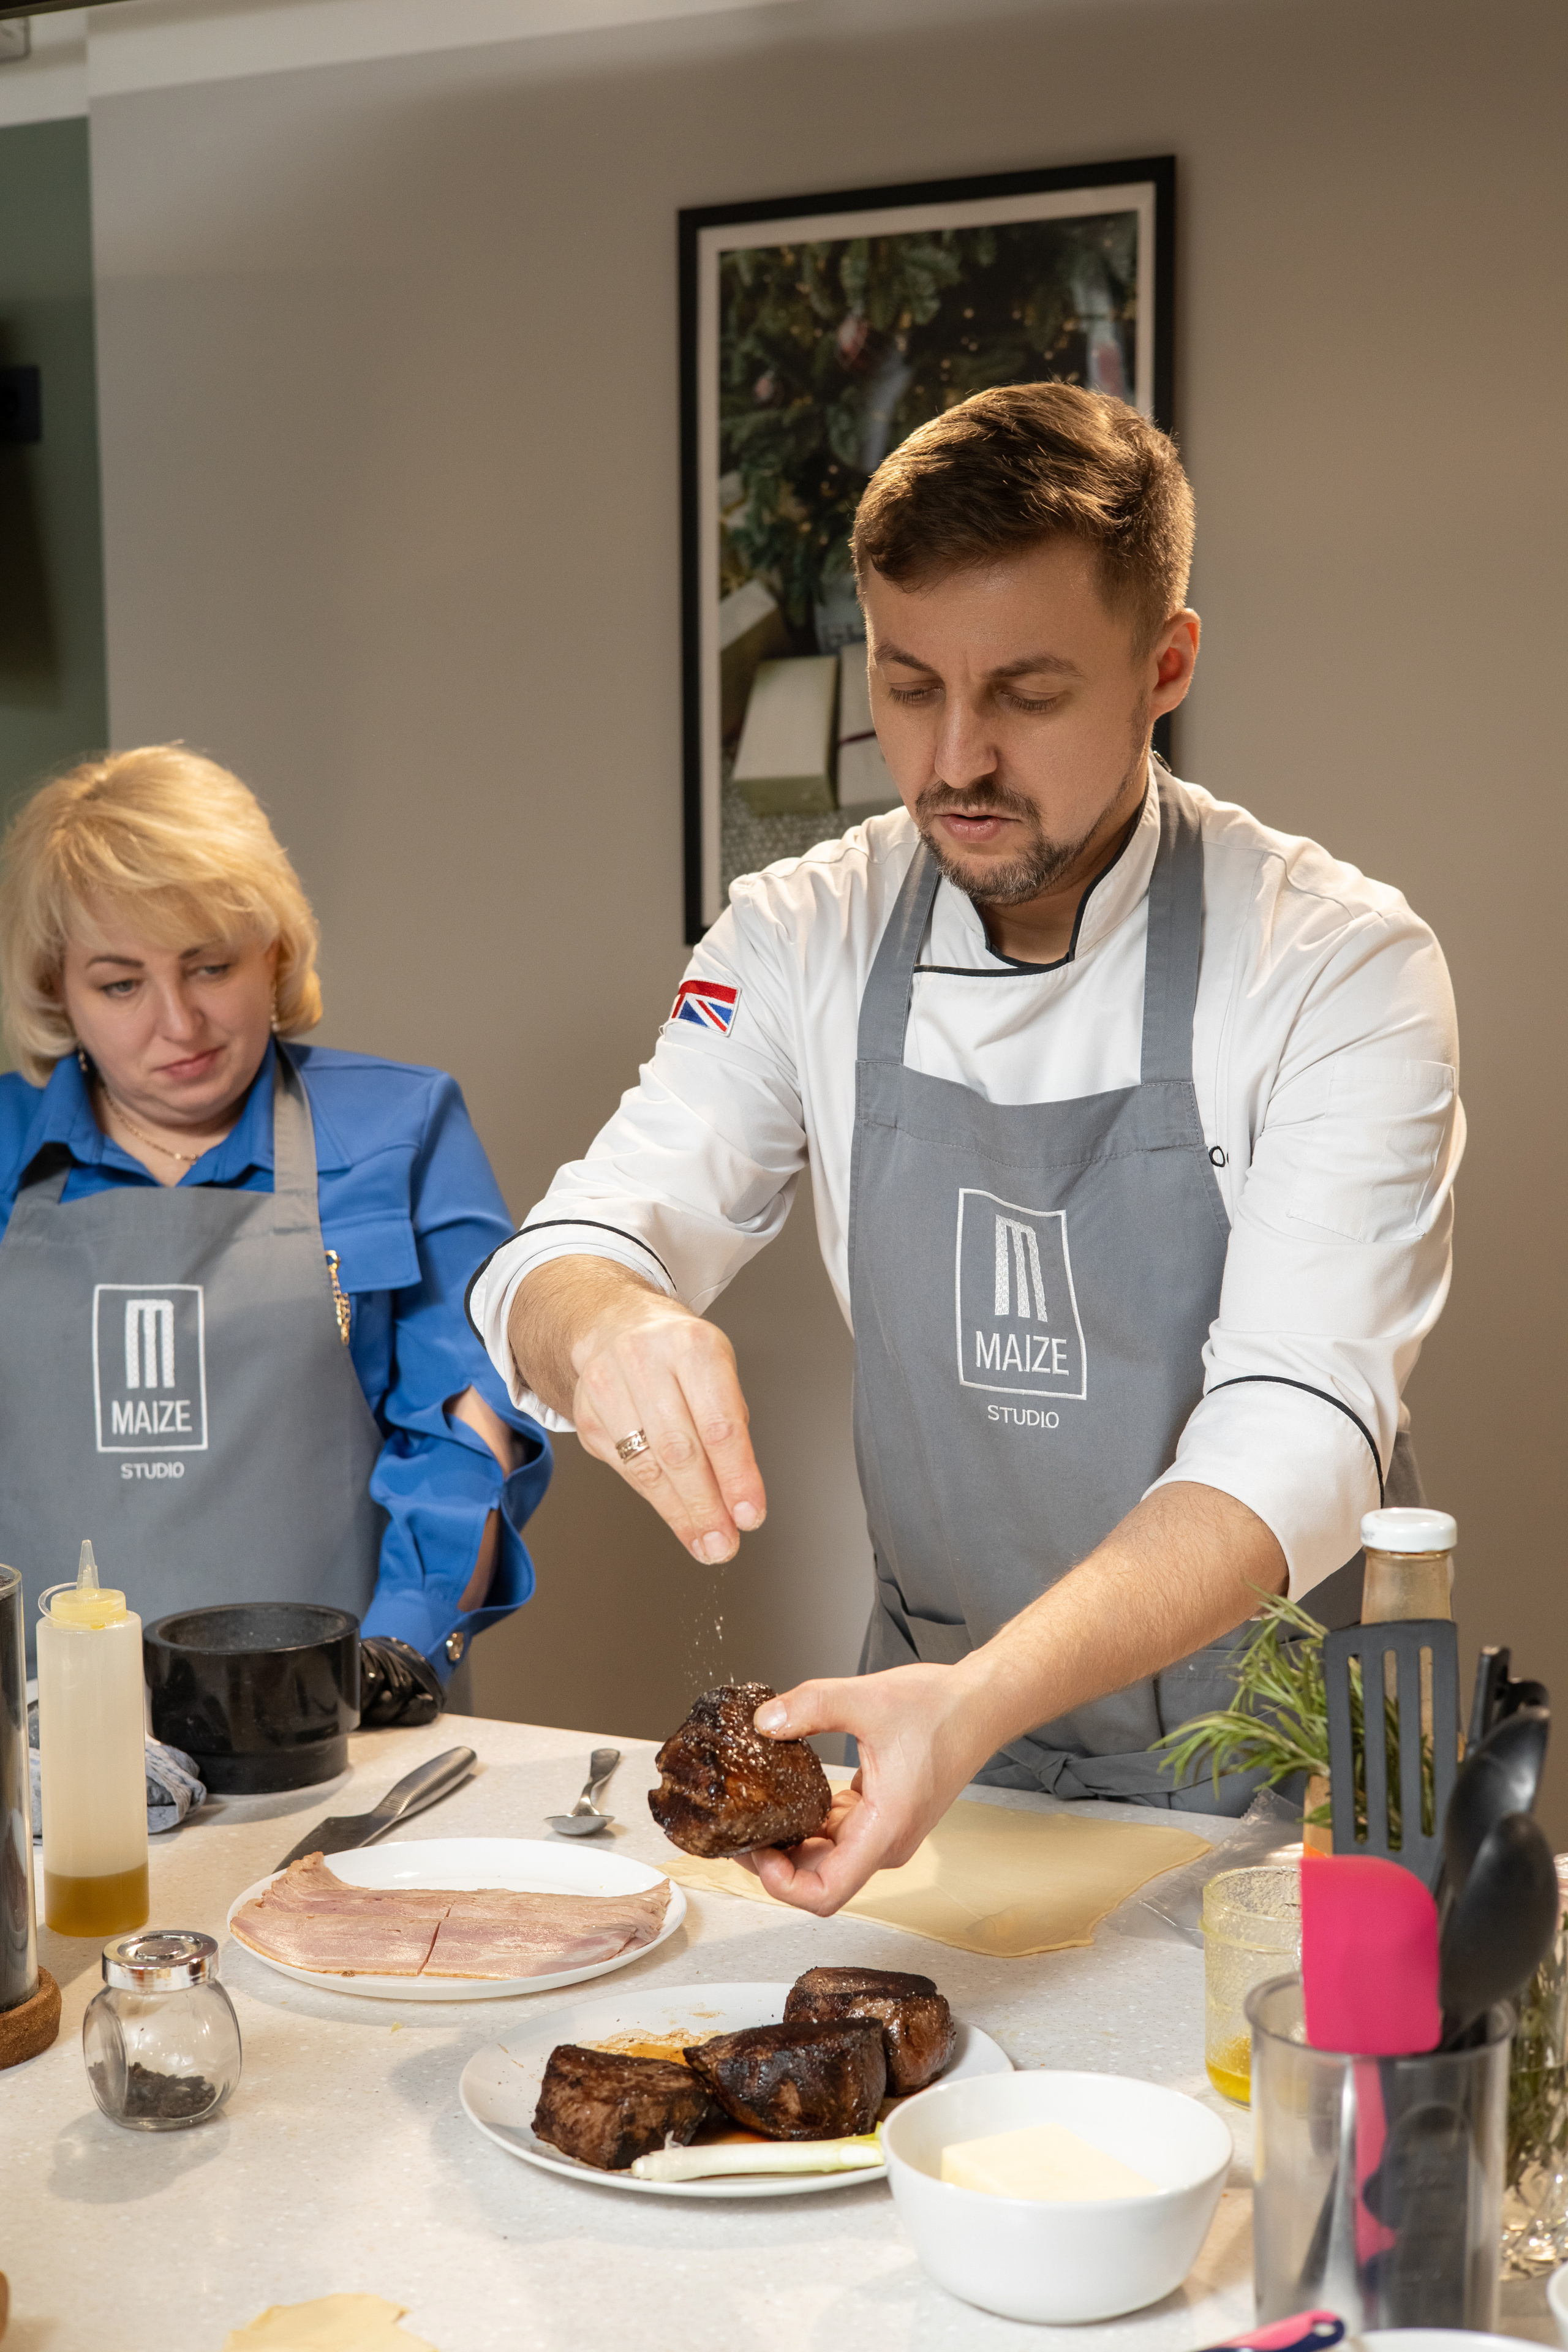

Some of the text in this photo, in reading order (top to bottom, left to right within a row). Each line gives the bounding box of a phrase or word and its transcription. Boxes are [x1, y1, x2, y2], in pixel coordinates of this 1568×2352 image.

[976, 1331, 1069, 1376] MAIZE
[111, 1400, 192, 1434] MAIZE
[987, 1405, 1059, 1428] STUDIO
[121, 1461, 184, 1479] STUDIO
